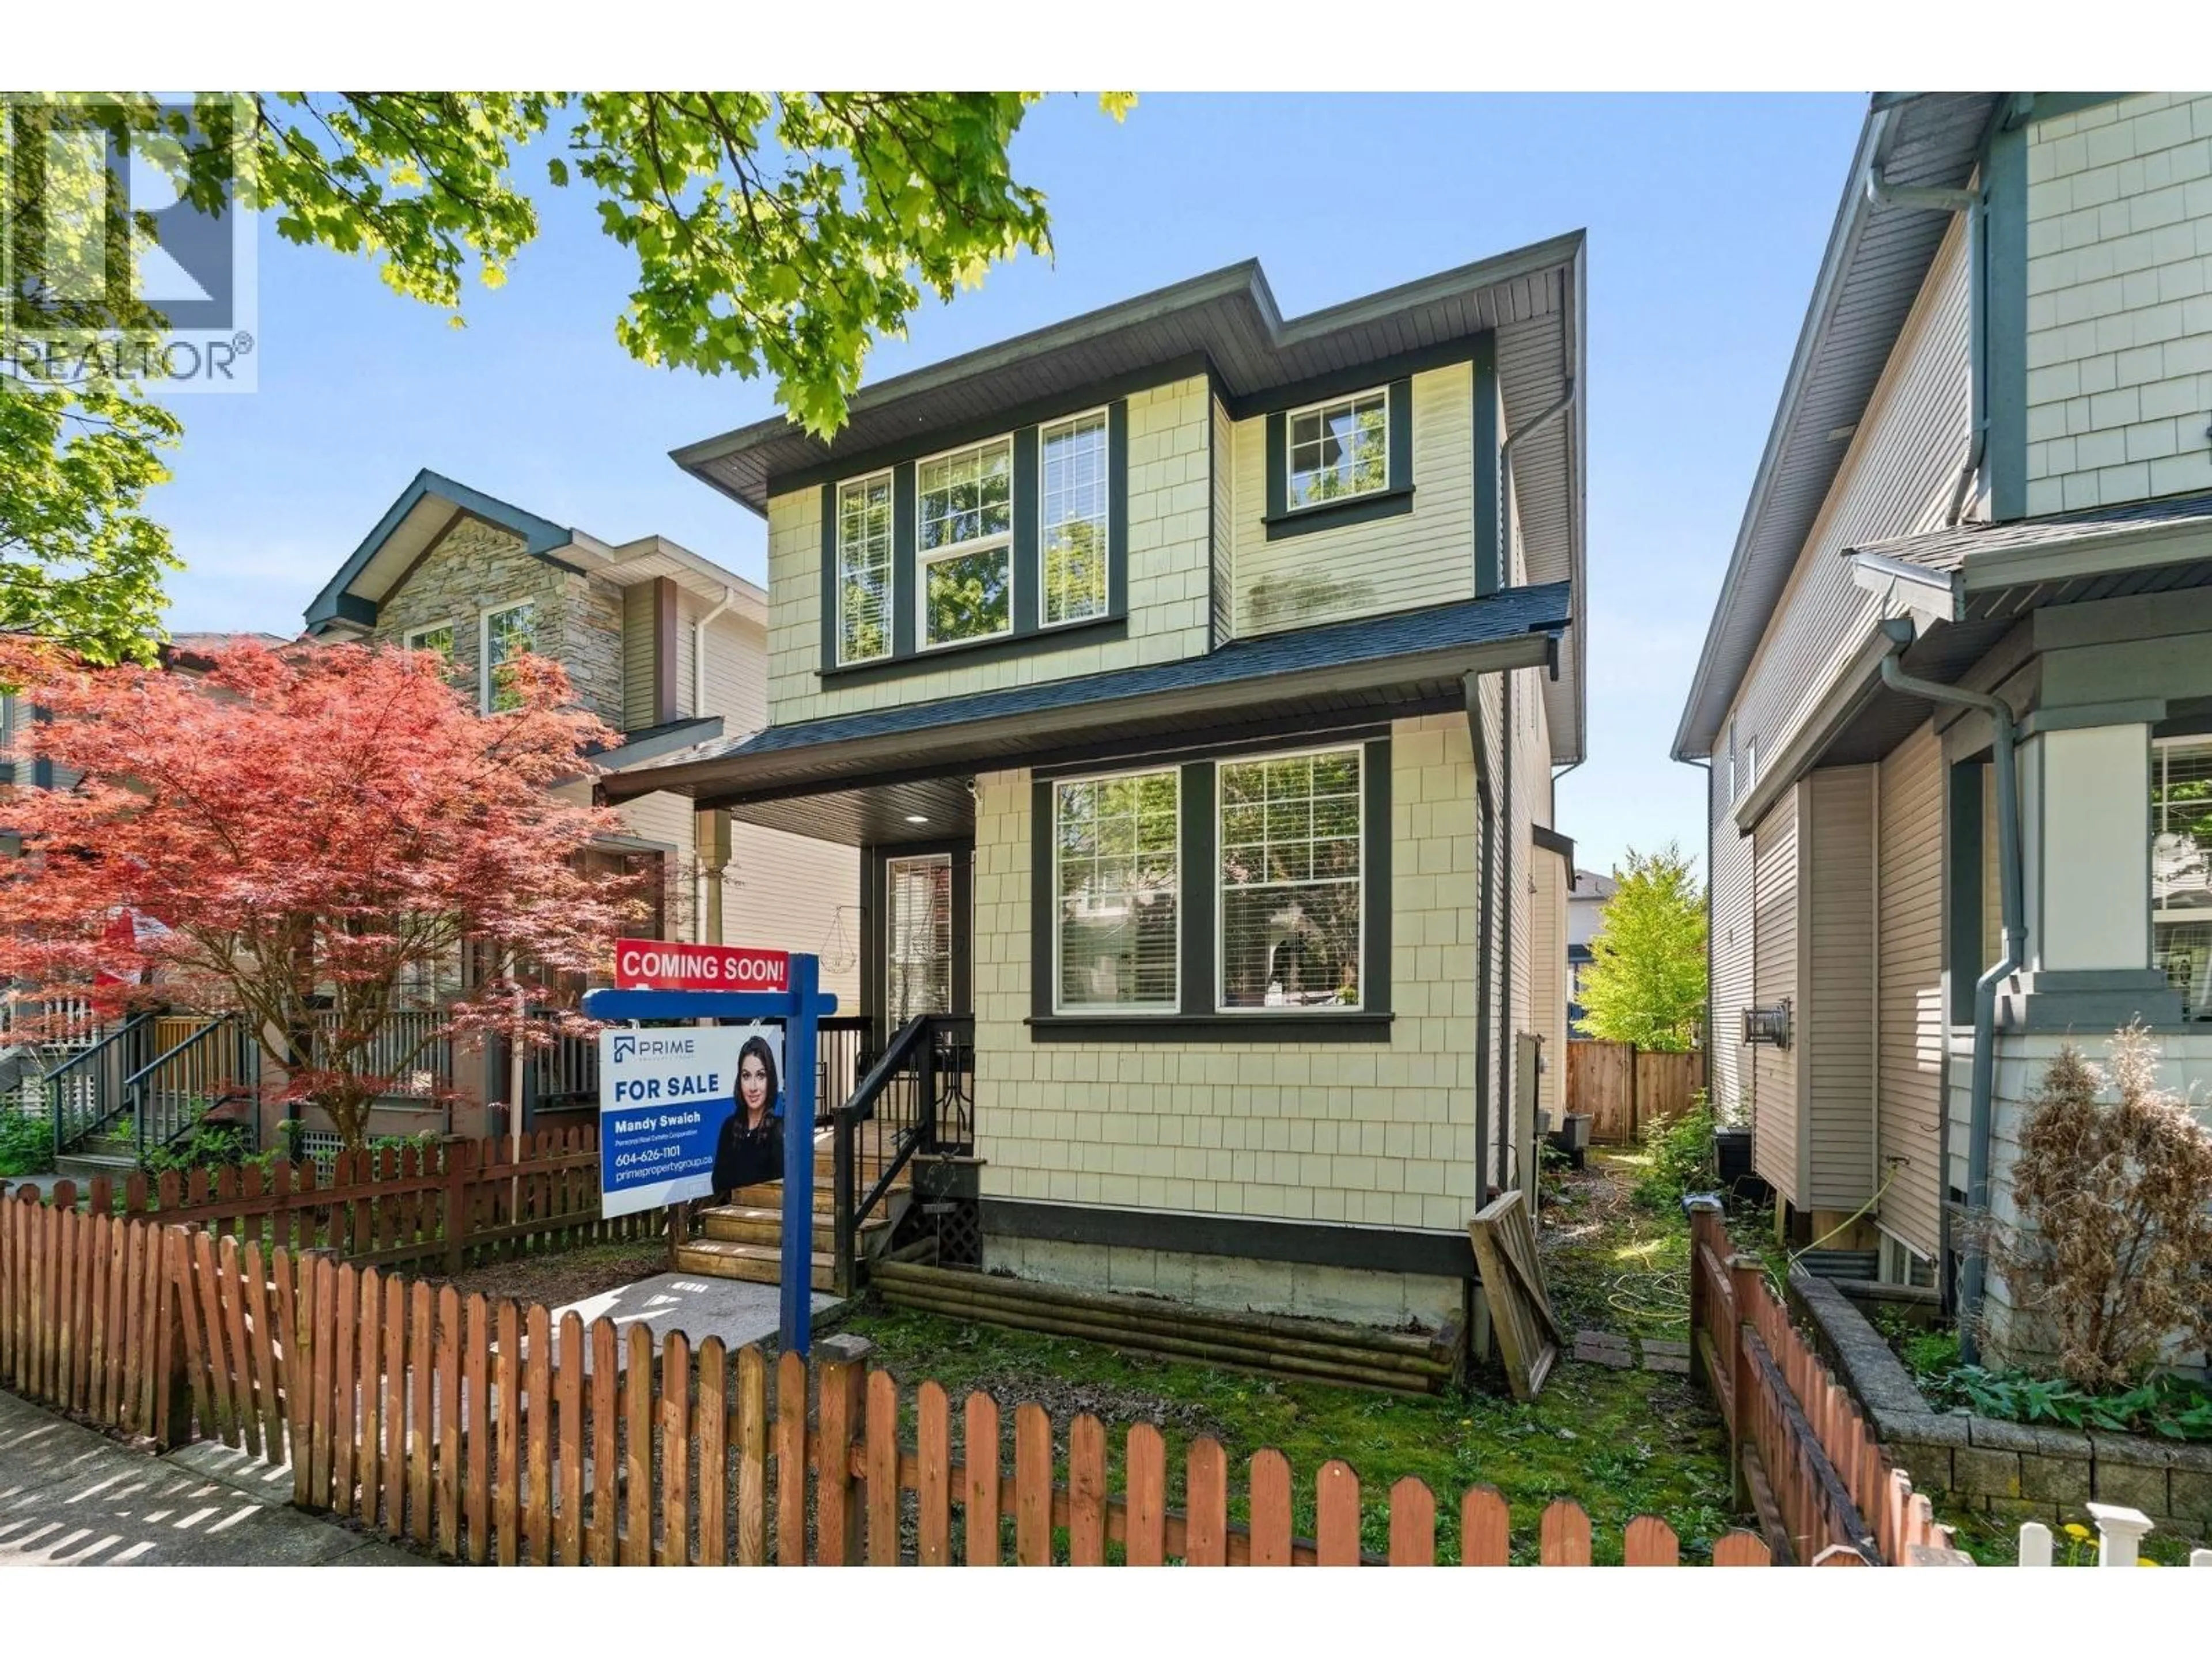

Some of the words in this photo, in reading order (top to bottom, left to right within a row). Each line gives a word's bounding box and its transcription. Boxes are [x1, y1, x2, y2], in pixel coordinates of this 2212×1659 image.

[622, 951, 719, 979] COMING
[724, 957, 784, 981] SOON!
[639, 1039, 695, 1056] PRIME
[615, 1079, 661, 1103] FOR
[668, 1073, 719, 1097] SALE
[615, 1117, 657, 1134] Mandy
[615, 1145, 680, 1168] 604-626-1101
[615, 1155, 713, 1183] primepropertygroup.ca
